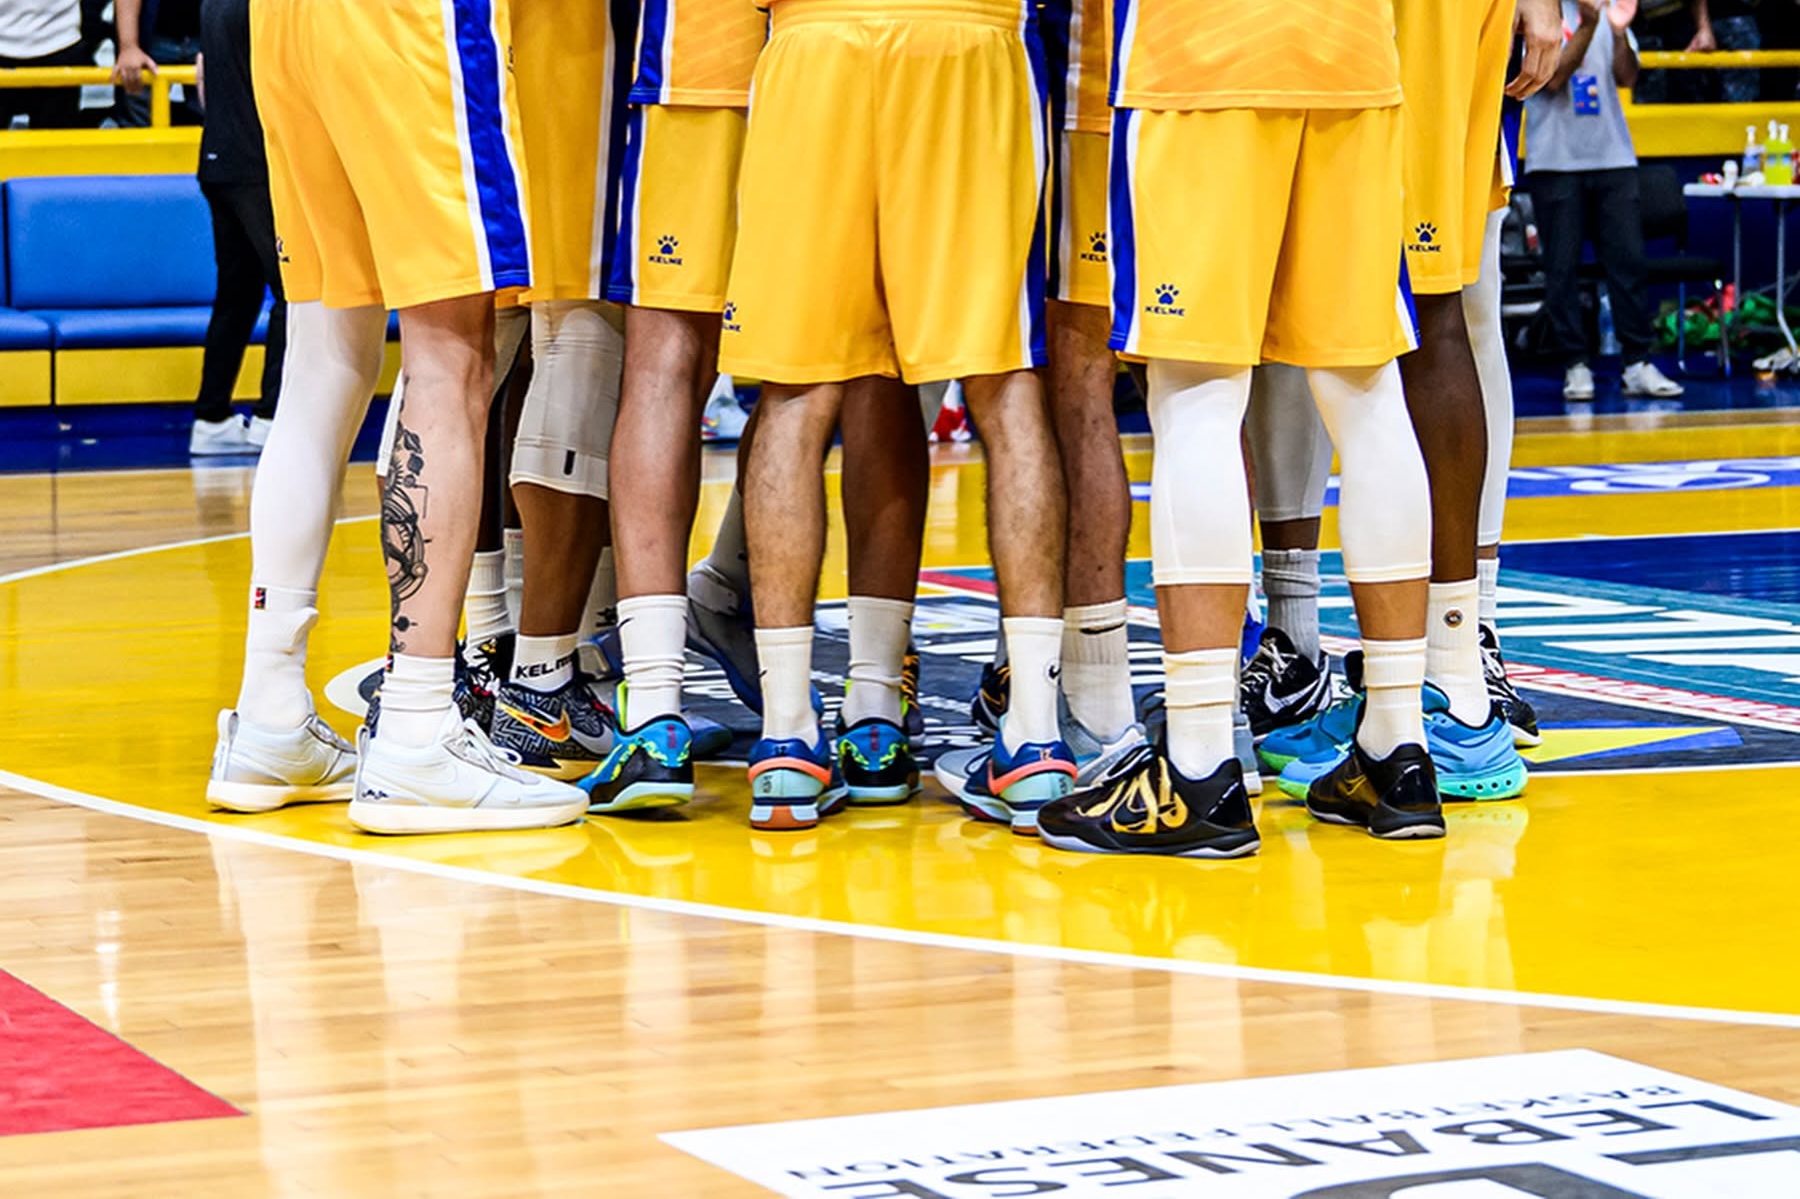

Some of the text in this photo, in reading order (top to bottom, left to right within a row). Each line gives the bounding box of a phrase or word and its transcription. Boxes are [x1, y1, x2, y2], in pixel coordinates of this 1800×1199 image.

[786, 1084, 1682, 1180] BASKETBALL FEDERATION
[821, 1099, 1776, 1199] LEBANESE
